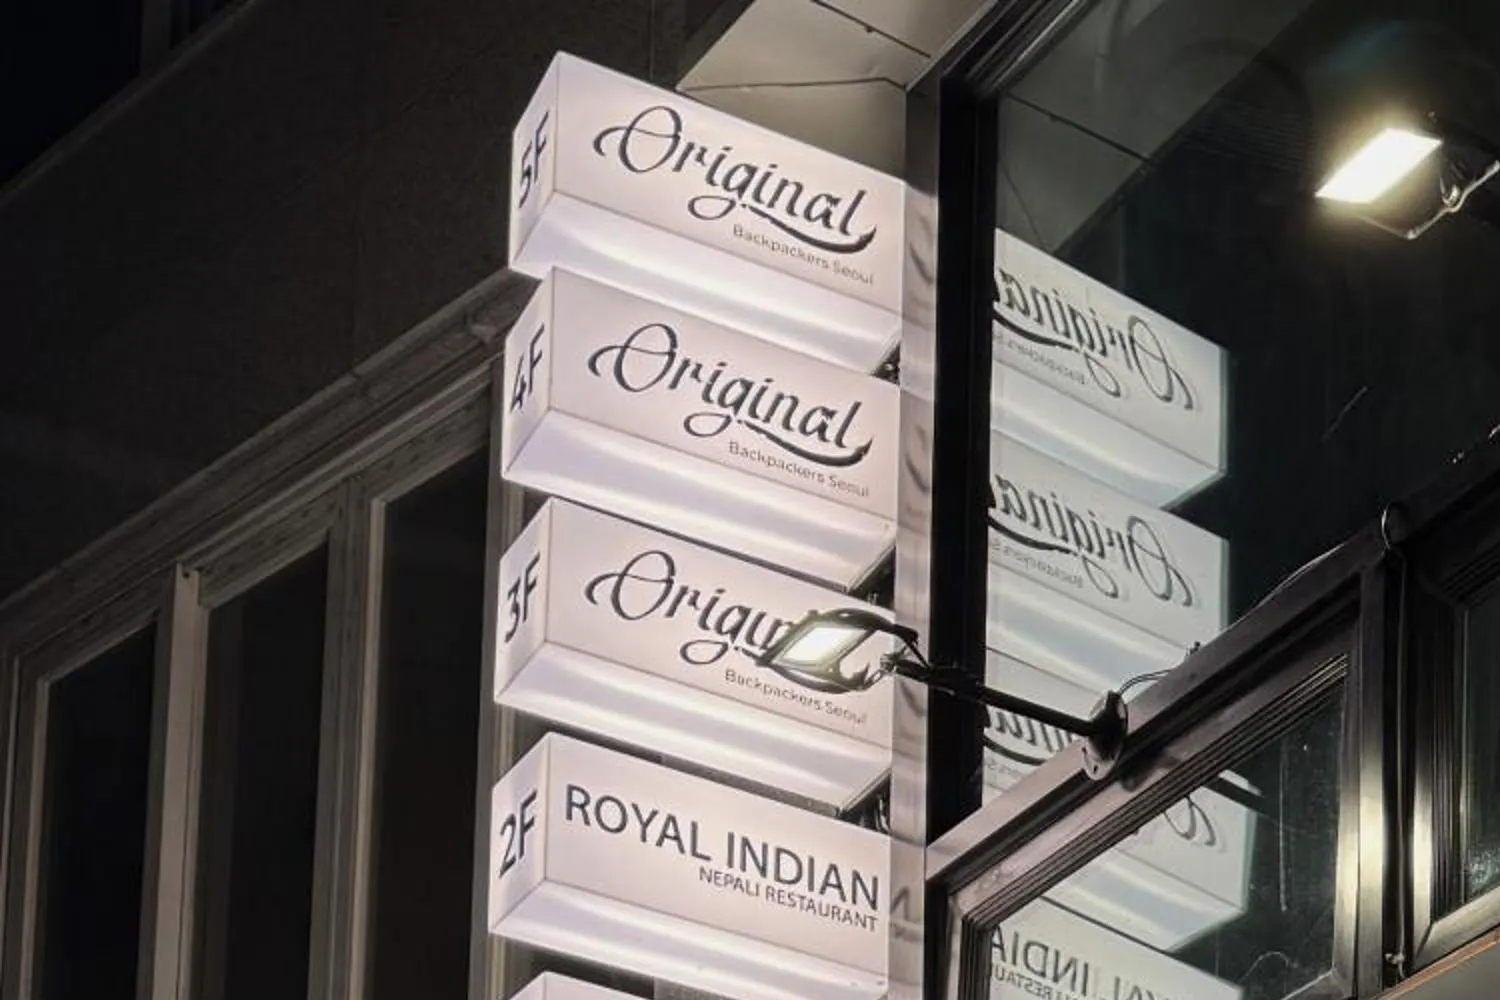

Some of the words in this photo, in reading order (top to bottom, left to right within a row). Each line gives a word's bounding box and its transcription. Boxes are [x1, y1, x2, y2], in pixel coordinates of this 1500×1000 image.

[518, 110, 550, 209] 5F
[593, 106, 877, 254] Original
[733, 223, 829, 270] Backpackers
[832, 260, 875, 286] Seoul
[509, 322, 546, 413] 4F
[588, 323, 874, 467] Original
[728, 440, 826, 484] Backpackers
[828, 474, 870, 498] Seoul
[503, 551, 541, 643] 3F
[724, 667, 822, 711] Backpackers
[824, 701, 867, 725] Seoul
[498, 789, 539, 878] 2F
[565, 784, 711, 862] ROYAL
[725, 831, 880, 911] INDIAN
[700, 866, 761, 897] NEPALI
[765, 884, 878, 932] RESTAURANT
